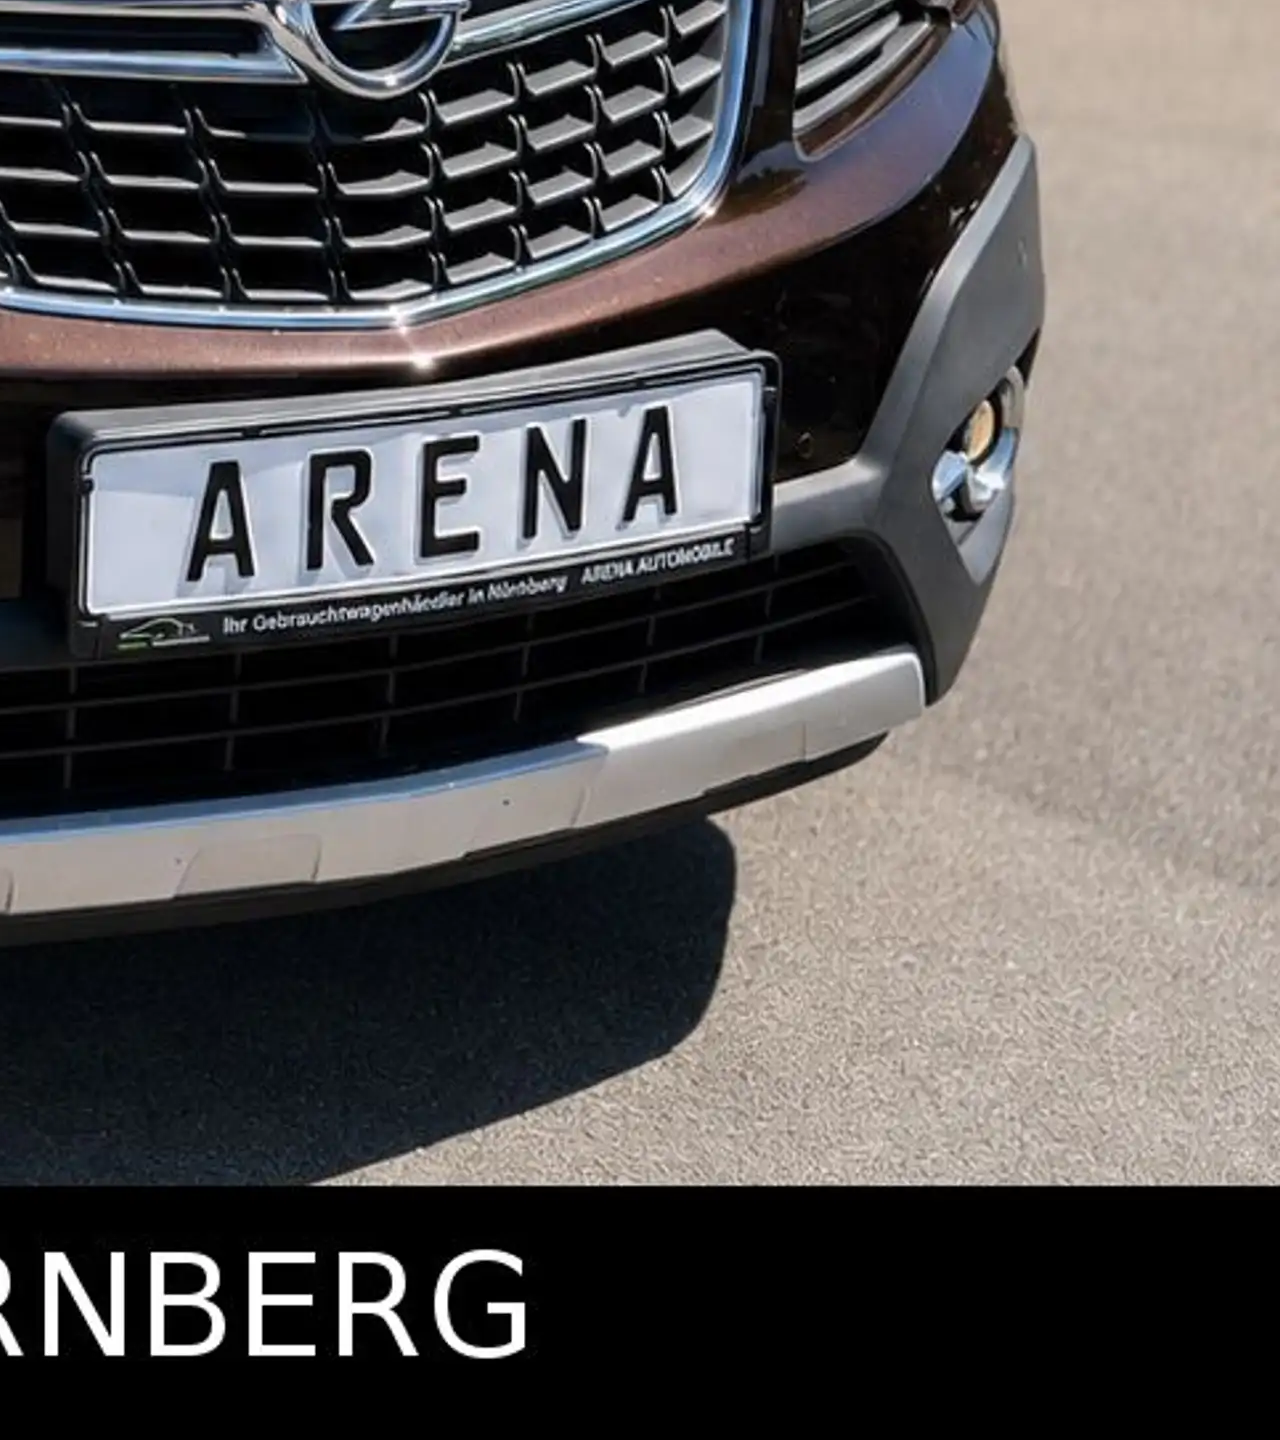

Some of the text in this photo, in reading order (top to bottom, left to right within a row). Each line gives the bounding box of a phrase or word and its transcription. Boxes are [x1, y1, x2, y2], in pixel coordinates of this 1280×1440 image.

[186, 405, 678, 582] ARENA
[223, 616, 248, 634] Ihr
[636, 537, 735, 574] AUTOMOBILE
